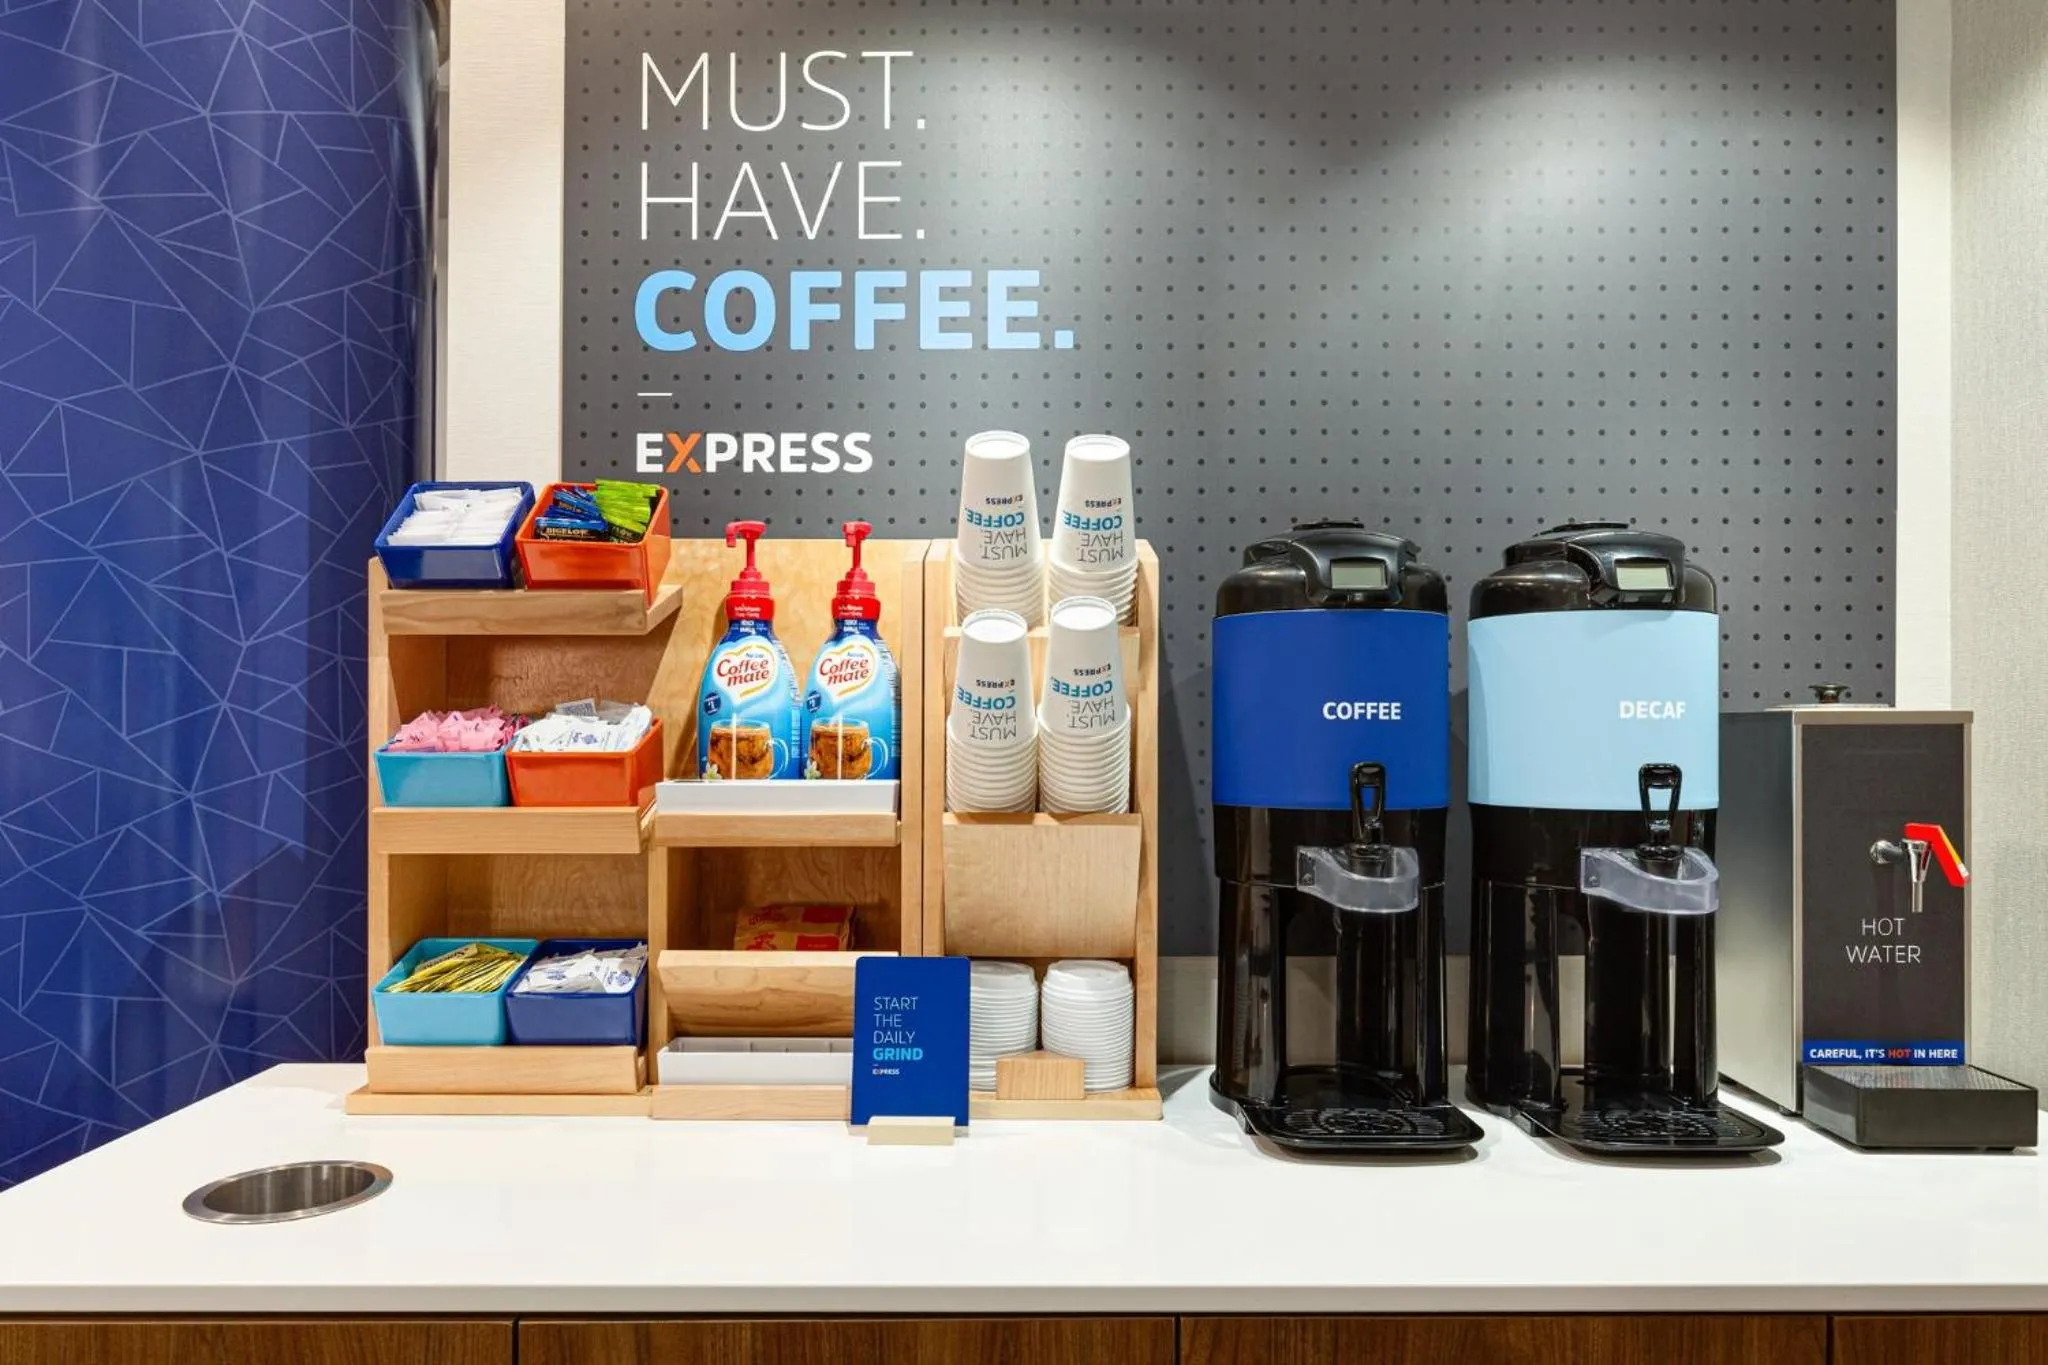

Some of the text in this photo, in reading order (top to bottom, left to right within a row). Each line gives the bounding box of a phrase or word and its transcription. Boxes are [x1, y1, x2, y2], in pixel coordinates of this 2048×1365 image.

[641, 50, 926, 131] MUST.
[641, 161, 926, 241] HAVE.
[634, 269, 1075, 352] COFFEE.
[635, 431, 873, 474] EXPRESS
[965, 507, 1025, 528] COFFEE.
[1063, 510, 1122, 531] COFFEE.
[981, 527, 1026, 545] HAVE.
[1079, 529, 1124, 547] HAVE.
[980, 542, 1028, 561] MUST.
[1076, 543, 1124, 563] MUST.
[717, 658, 769, 677] Coffee
[819, 658, 869, 676] Coffee
[827, 667, 870, 685] mate
[727, 669, 770, 687] mate
[1050, 676, 1113, 698] COFFEE.
[1067, 695, 1114, 714] HAVE.
[1322, 701, 1402, 721] COFFEE
[1618, 700, 1687, 720] DECAF
[970, 709, 1017, 726] HAVE.
[1066, 708, 1115, 729] MUST.
[968, 723, 1017, 741] MUST.
[1861, 917, 1906, 936] HOT
[1845, 944, 1922, 964] WATER
[873, 996, 919, 1011] START
[873, 1013, 903, 1028] THE
[873, 1030, 916, 1045] DAILY
[872, 1047, 924, 1061] GRIND
[1809, 1048, 1958, 1060] CAREFUL, IT'S HOT IN HERE
